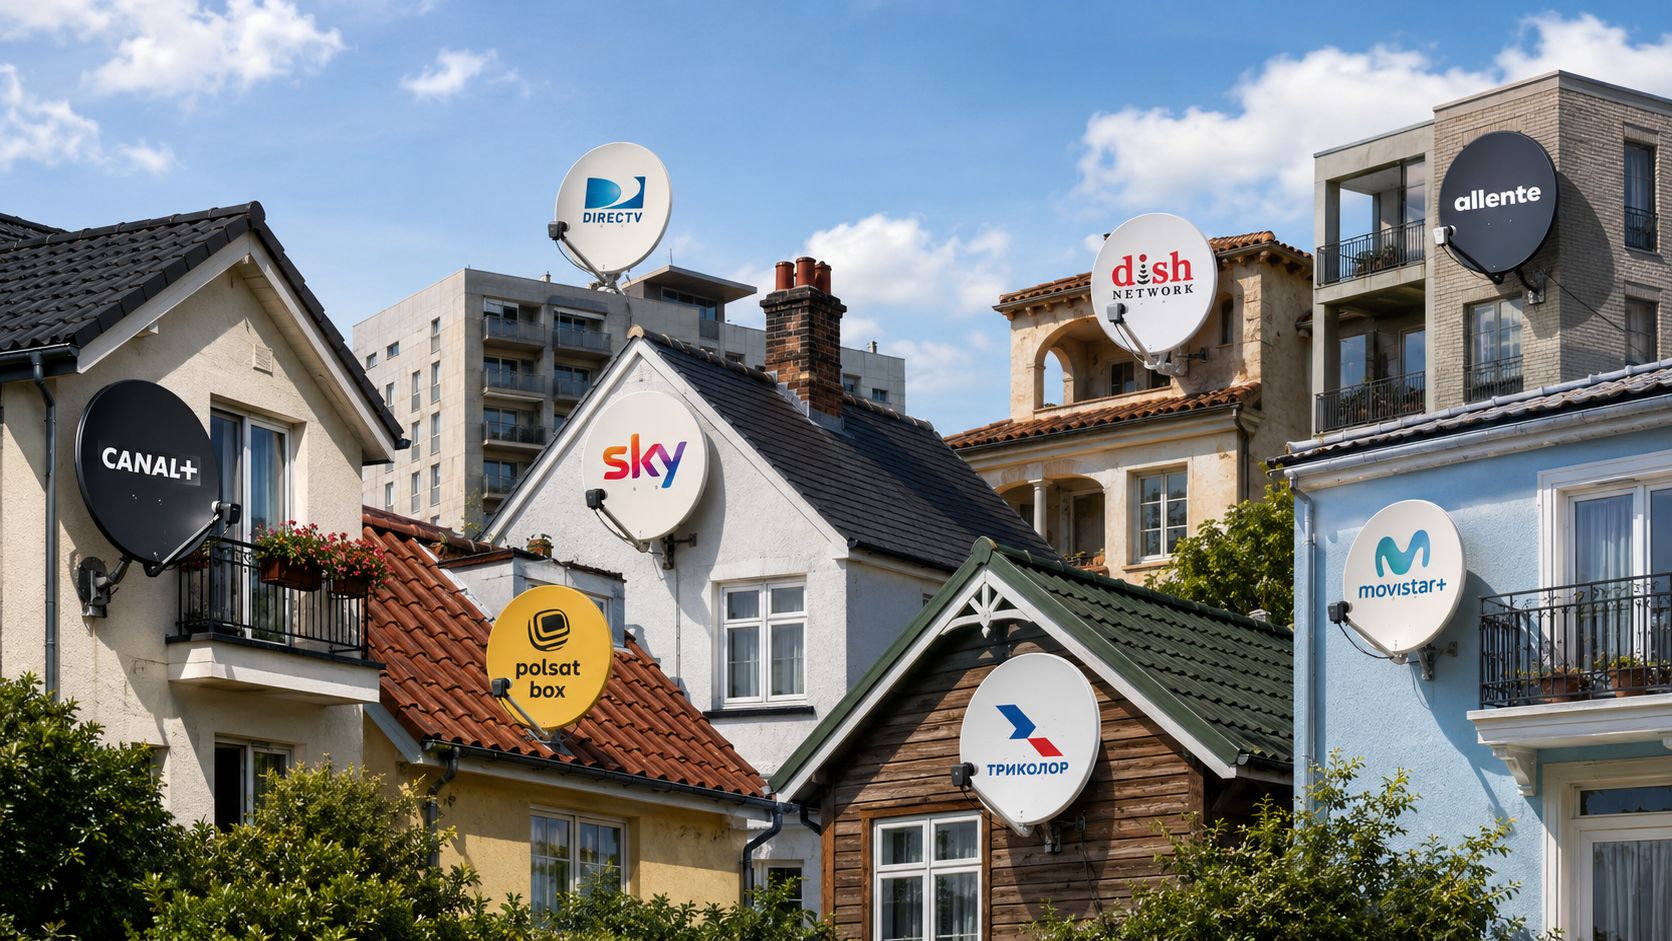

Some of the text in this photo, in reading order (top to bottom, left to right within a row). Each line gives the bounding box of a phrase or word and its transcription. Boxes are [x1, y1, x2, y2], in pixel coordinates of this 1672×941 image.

[1454, 186, 1541, 211] allente
[583, 212, 643, 223] DIRECTV
[1112, 251, 1193, 287] dish
[1112, 284, 1194, 300] NETWORK
[102, 447, 197, 481] CANAL+
[603, 433, 687, 489] sky
[1359, 578, 1447, 599] movistar+
[516, 658, 580, 679] polsat
[530, 681, 566, 698] box
[987, 762, 1069, 776] ТРИКОЛОР
